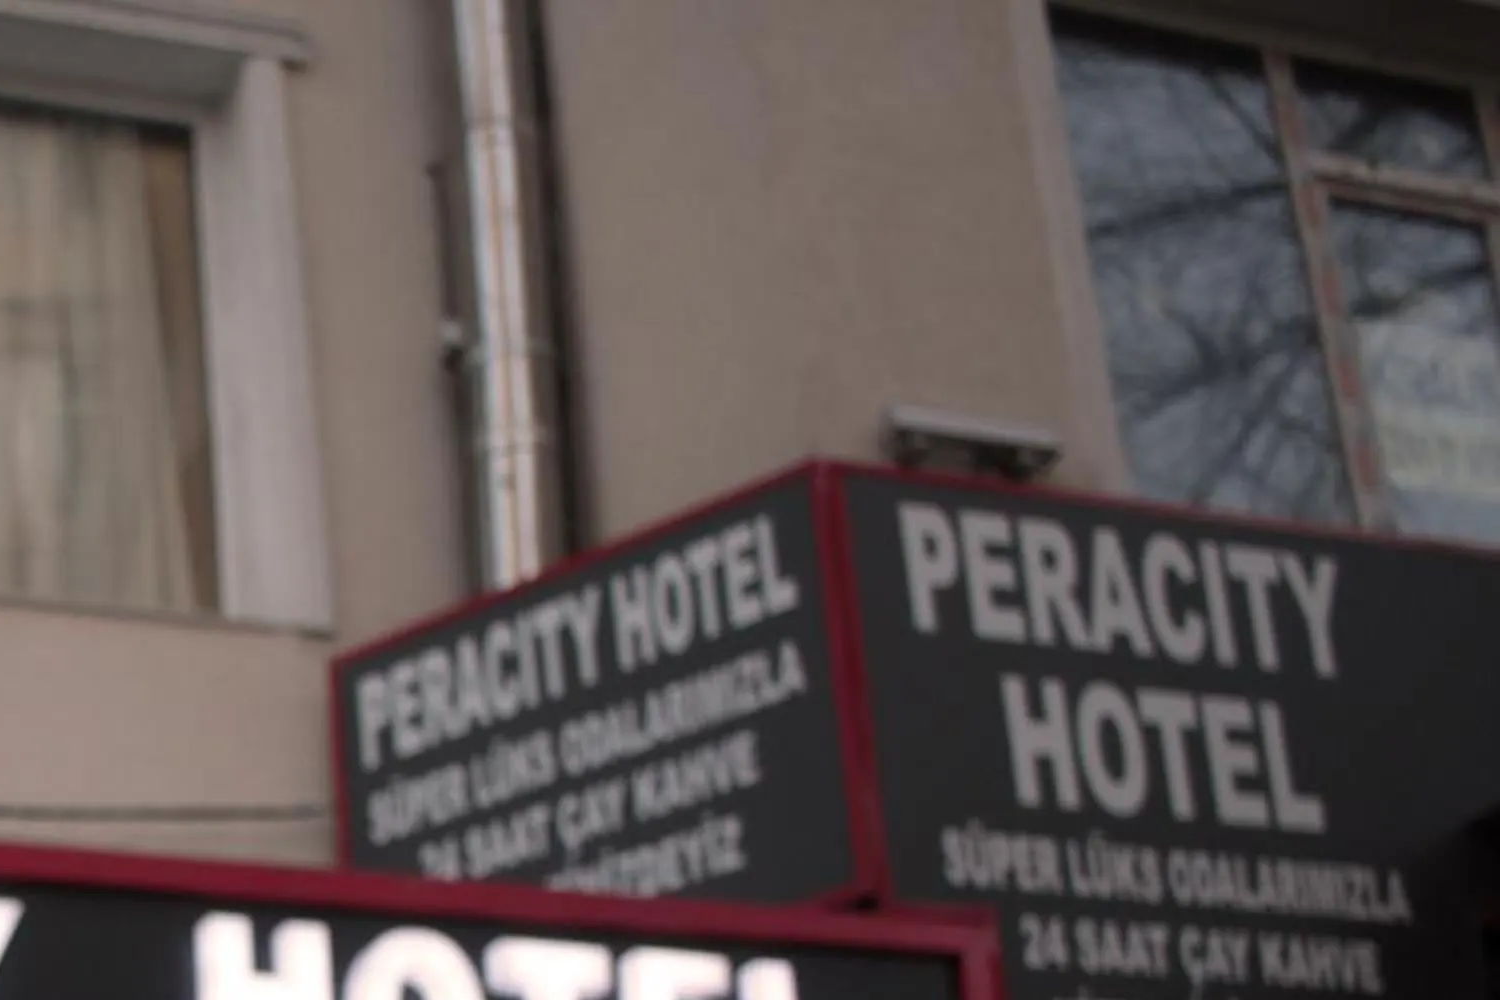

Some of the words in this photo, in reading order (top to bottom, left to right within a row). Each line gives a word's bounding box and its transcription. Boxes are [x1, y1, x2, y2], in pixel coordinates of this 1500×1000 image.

[355, 582, 601, 773] PERACITY
[609, 512, 798, 673] HOTEL
[898, 500, 1338, 680] PERACITY
[1001, 670, 1326, 834] HOTEL
[940, 817, 1064, 895] SÜPER
[1066, 831, 1163, 906] LÜKS
[1018, 911, 1070, 973] 24
[1075, 915, 1170, 980] SAAT
[1257, 928, 1384, 996] KAHVE
